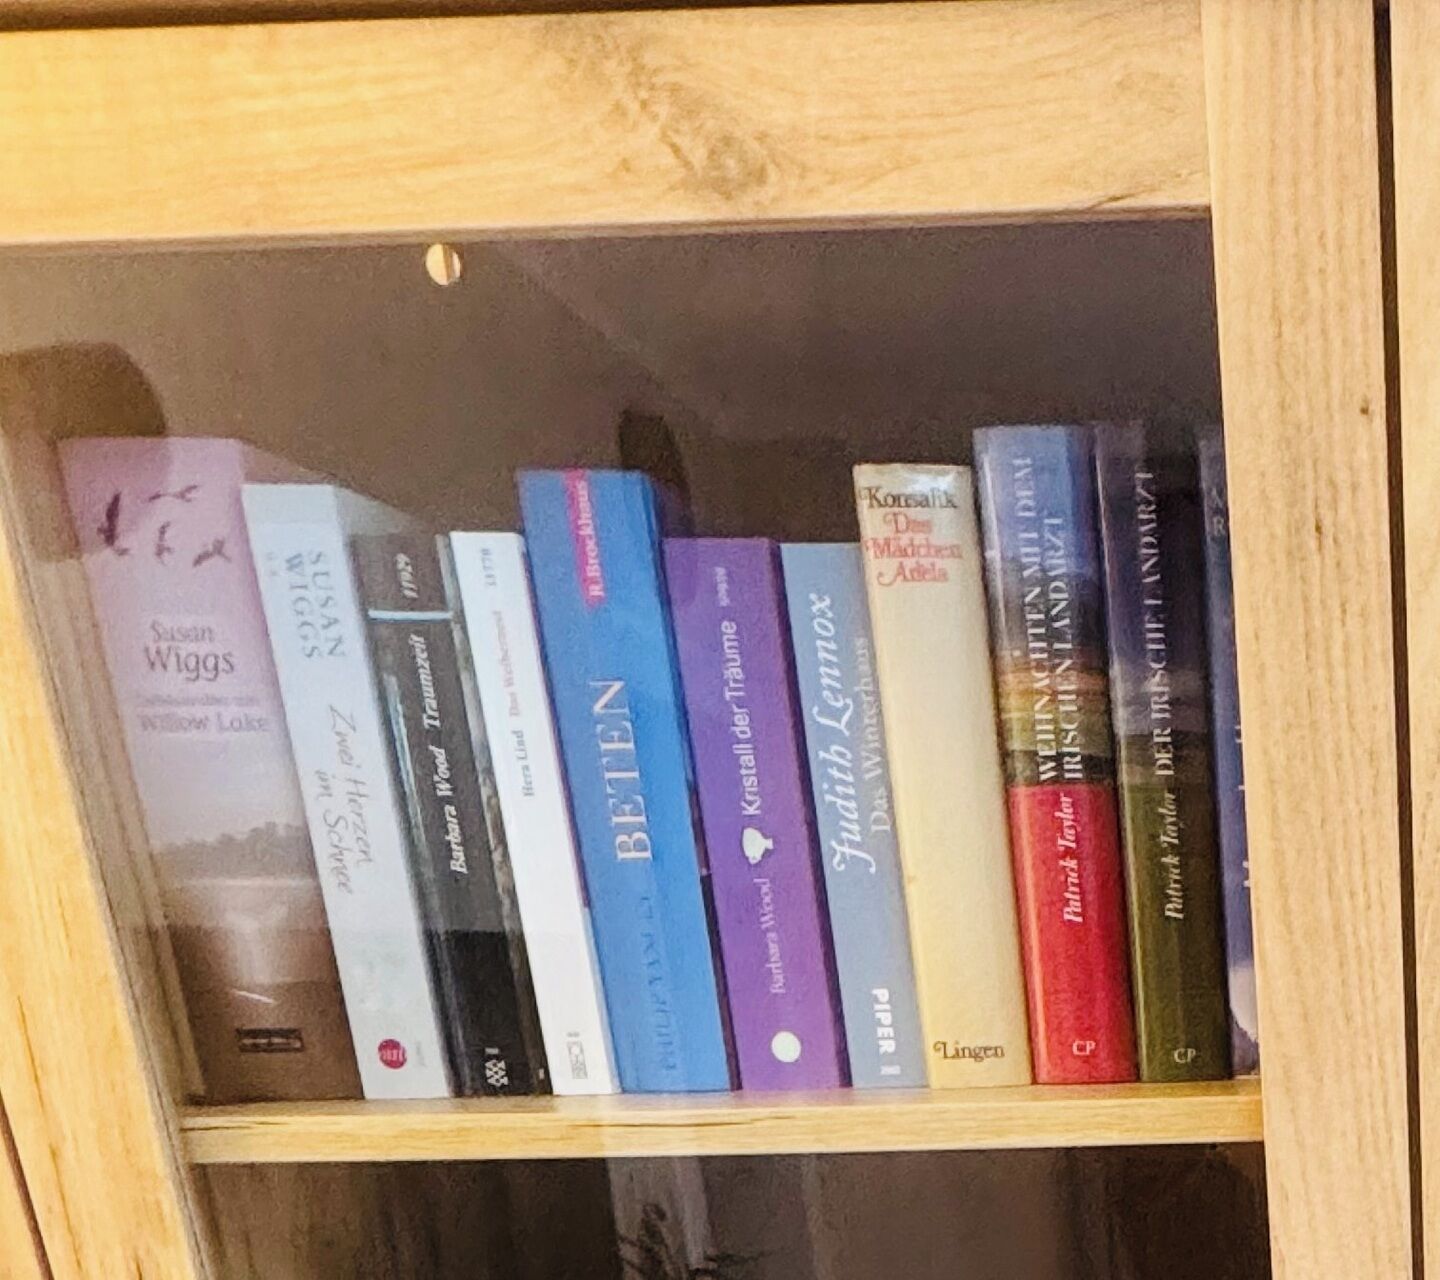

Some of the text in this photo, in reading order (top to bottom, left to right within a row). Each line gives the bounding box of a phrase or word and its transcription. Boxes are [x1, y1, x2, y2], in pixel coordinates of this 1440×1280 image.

[1012, 456, 1036, 517] DEM
[577, 478, 604, 579] Brockhaus
[1135, 472, 1163, 607] LANDARZT
[150, 620, 216, 642] Susan
[285, 552, 322, 658] WIGGS
[308, 551, 347, 658] SUSAN
[144, 646, 236, 682] Wiggs
[720, 620, 746, 701] Träume
[1044, 516, 1084, 780] IRISCHEN LANDARZT
[1025, 586, 1057, 781] WEIHNACHTEN
[407, 632, 470, 876] Barbara Wood Traumzeit
[515, 729, 533, 762] Lind
[732, 703, 752, 741] der
[808, 592, 877, 874] Judith Lennox
[1153, 727, 1175, 776] DER
[520, 763, 537, 798] Hera
[589, 679, 653, 863] BETEN
[732, 743, 763, 816] Kristall
[869, 787, 891, 833] Das
[1157, 791, 1186, 846] Taylor
[1054, 792, 1085, 923] Patrick Taylor
[1161, 854, 1185, 920] Patrick
[757, 876, 772, 928] Wood
[872, 988, 896, 1057] PIPER
[933, 1038, 1006, 1063] Lingen
